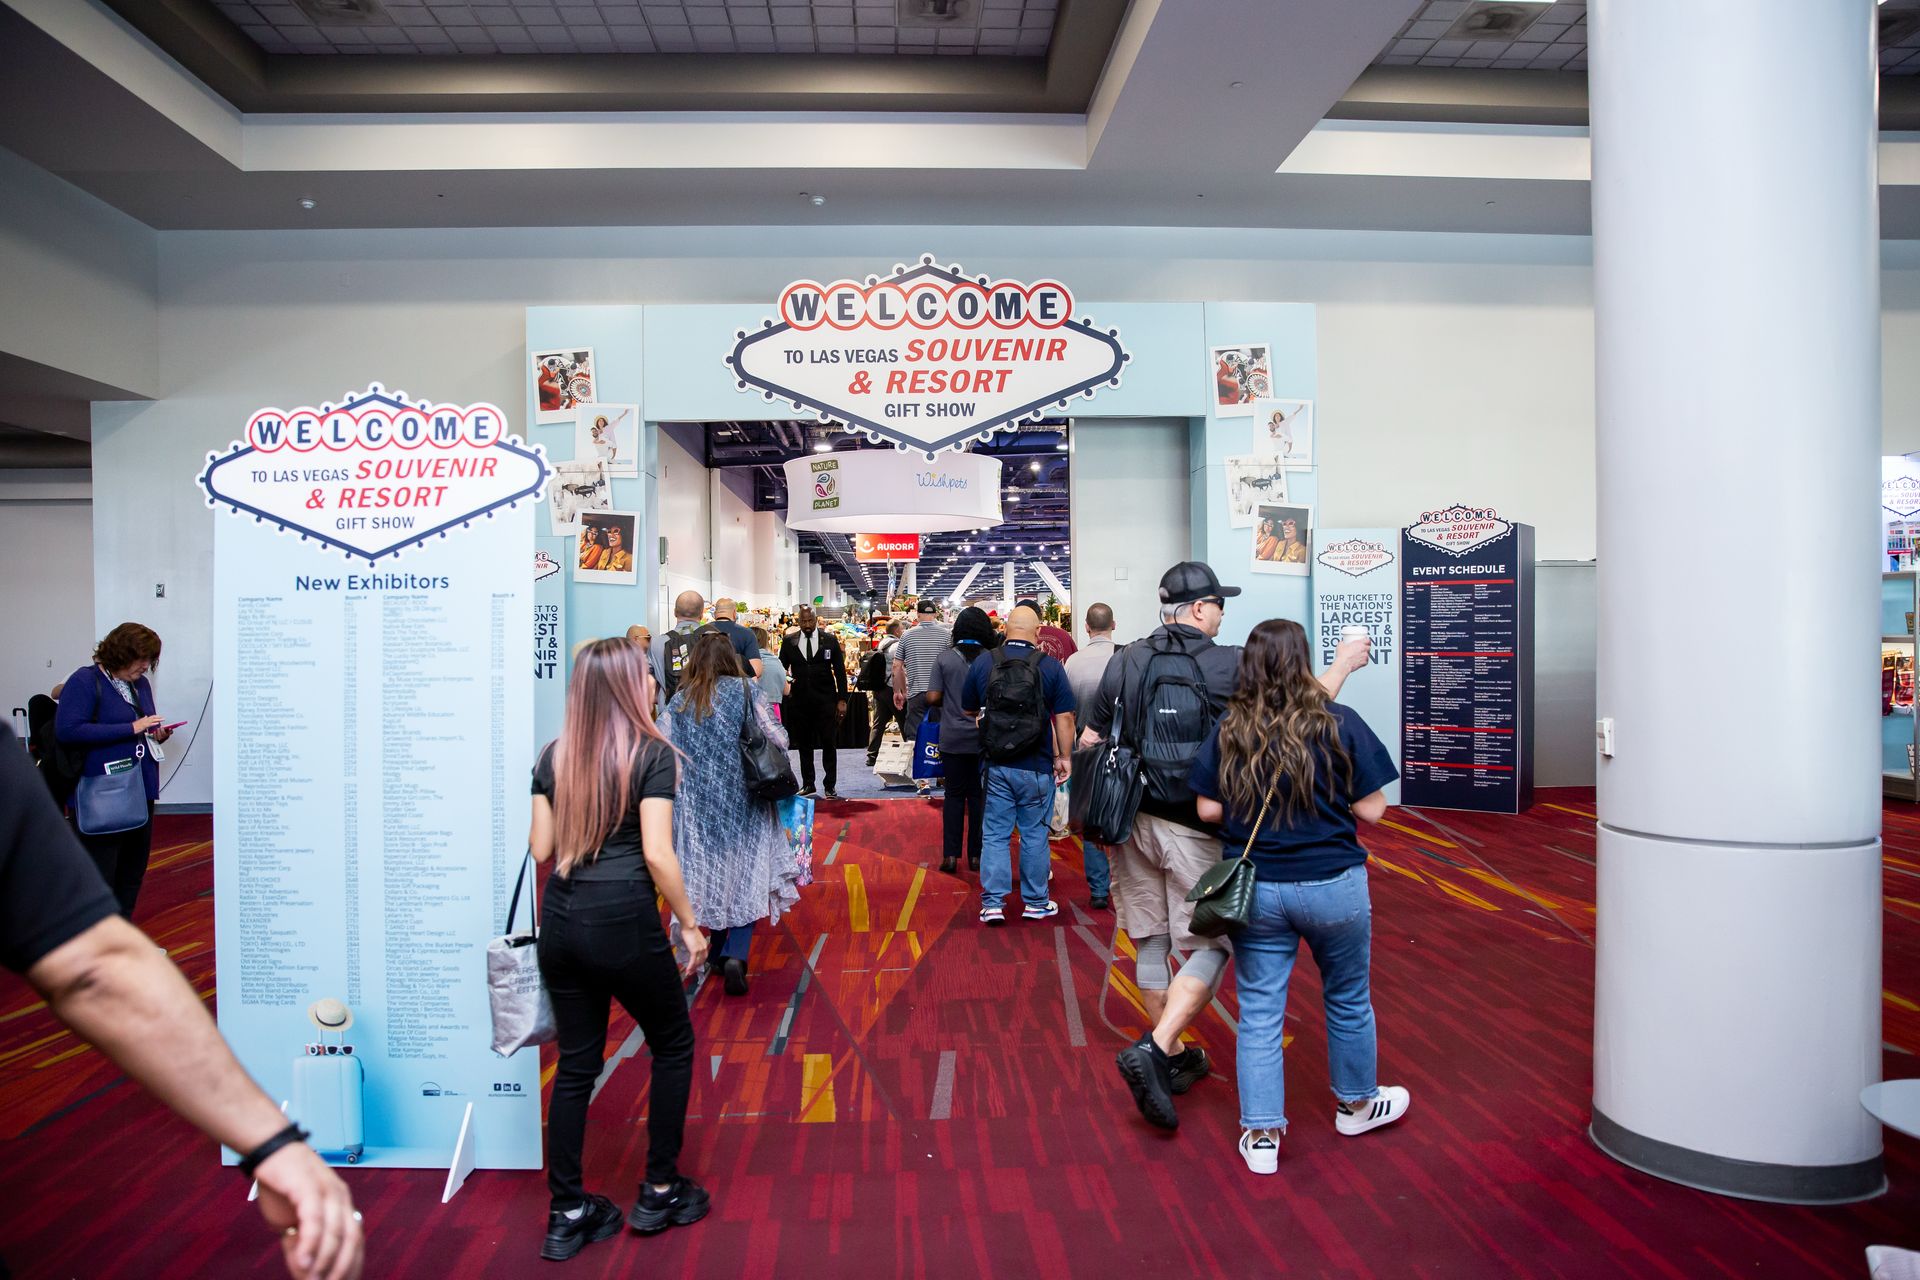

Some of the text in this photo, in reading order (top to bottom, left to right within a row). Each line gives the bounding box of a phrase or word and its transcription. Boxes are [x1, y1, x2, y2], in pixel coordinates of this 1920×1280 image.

[791, 293, 1058, 321] WELCOME
[784, 339, 1067, 364] TO LAS VEGAS SOUVENIR
[849, 370, 1012, 394] & RESORT
[885, 403, 975, 418] GIFT SHOW
[258, 416, 489, 444] WELCOME
[252, 458, 498, 483] TO LAS VEGAS SOUVENIR
[812, 461, 837, 470] NATURE
[916, 472, 968, 492] Wishpets
[306, 487, 448, 509] & RESORT
[815, 499, 837, 508] PLANET
[1423, 511, 1492, 521] WELCOME
[336, 517, 415, 530] GIFT SHOW
[1452, 523, 1494, 531] SOUVENIR
[877, 542, 914, 551] AURORA
[1413, 565, 1505, 575] EVENT SCHEDULE
[296, 574, 449, 590] New Exhibitors
[1322, 612, 1392, 623] LARGEST
[1322, 624, 1392, 636] RET &
[548, 637, 557, 648] &
[1322, 637, 1391, 647] SONIR
[1324, 649, 1392, 665] ENT
